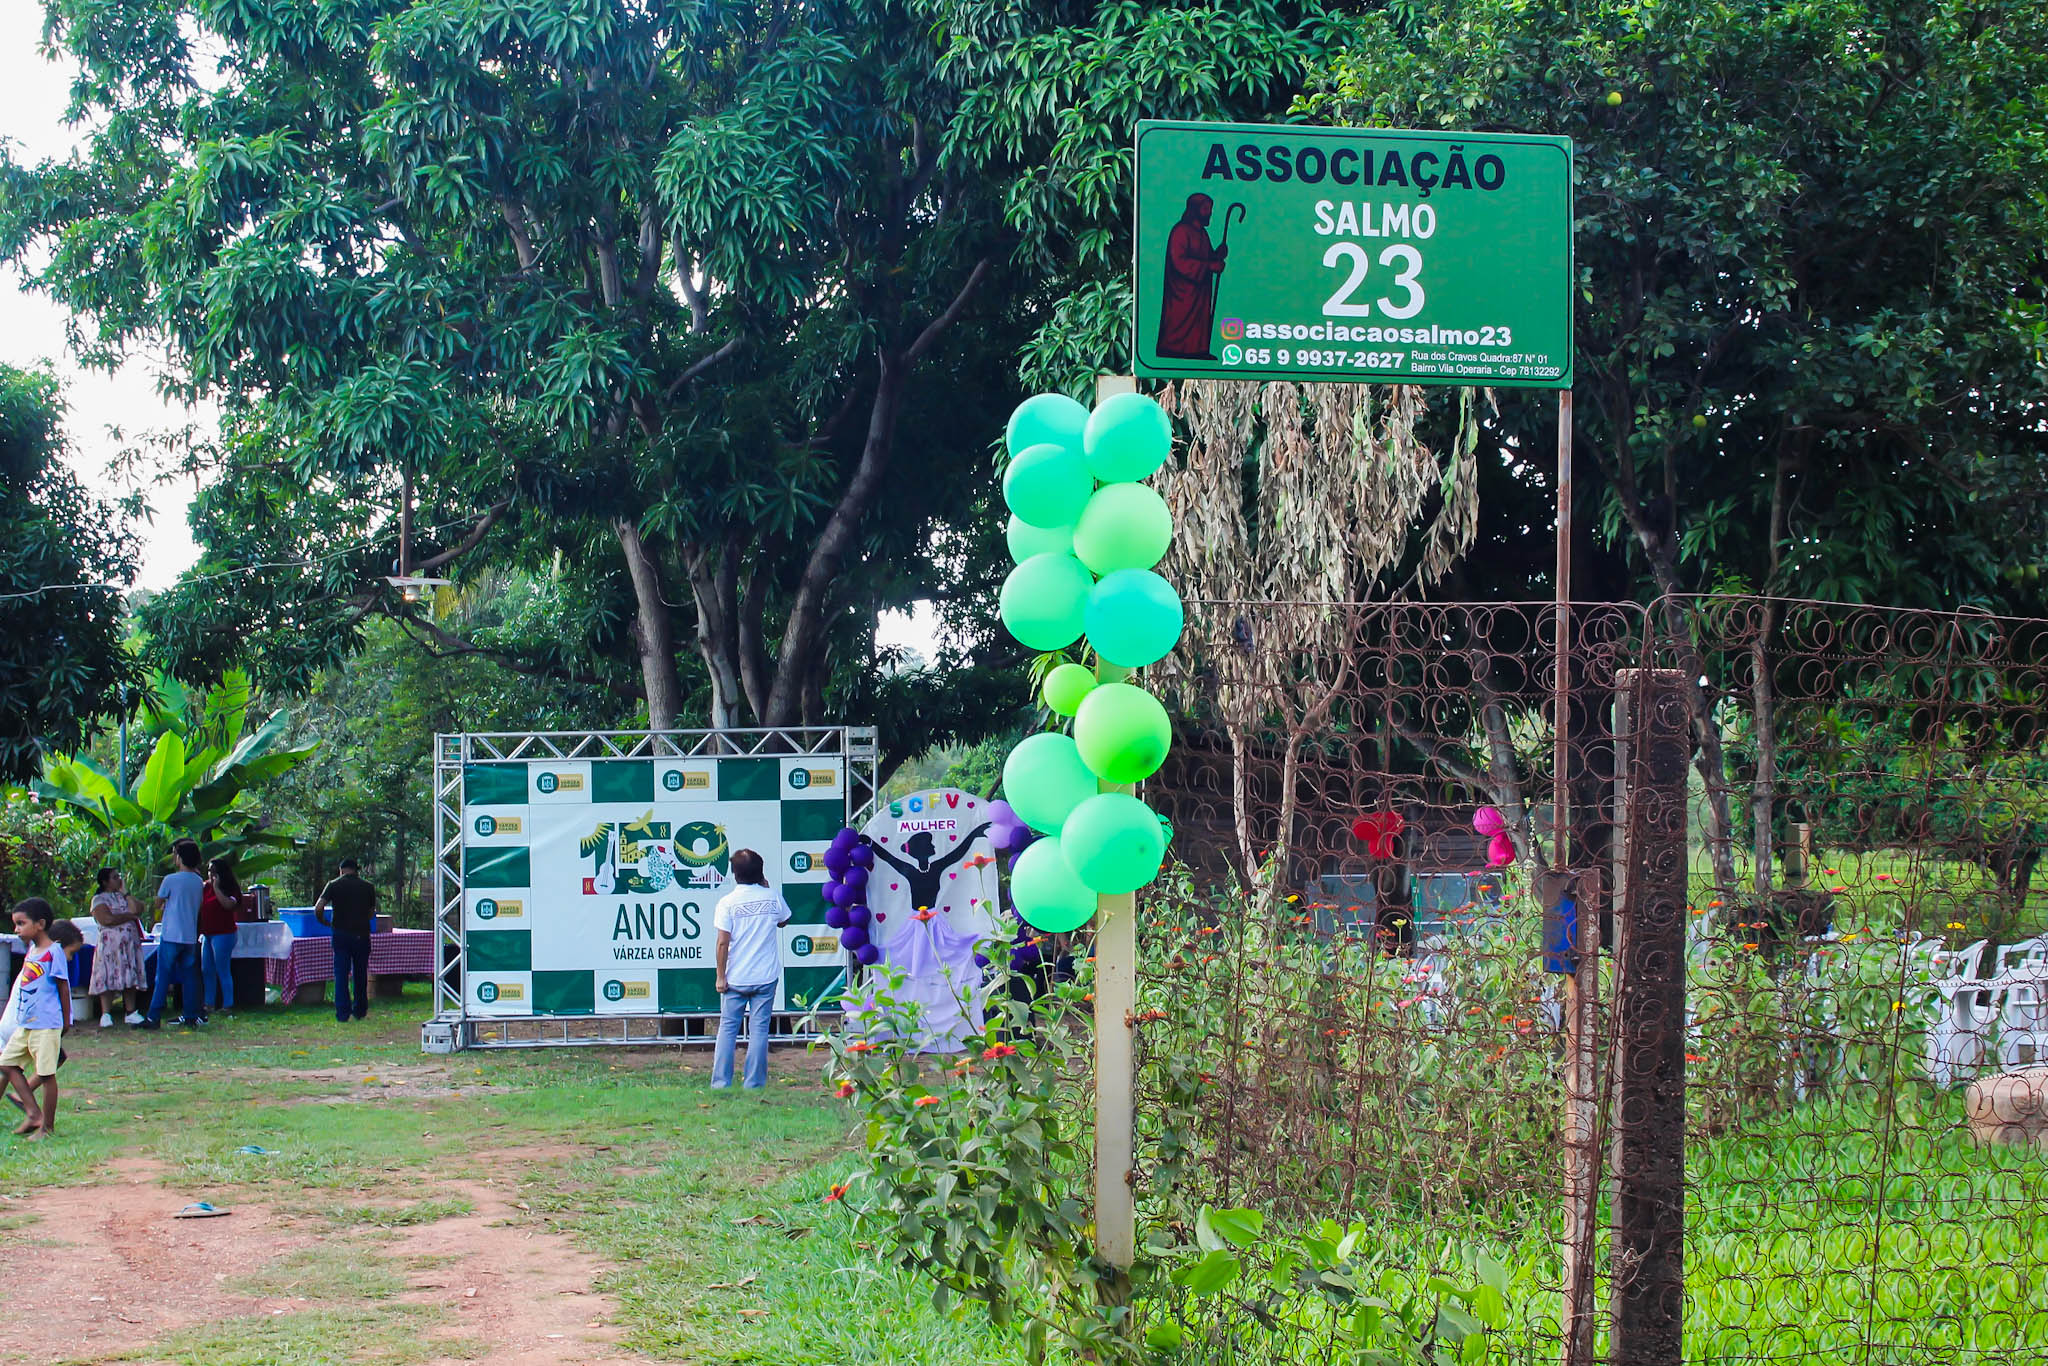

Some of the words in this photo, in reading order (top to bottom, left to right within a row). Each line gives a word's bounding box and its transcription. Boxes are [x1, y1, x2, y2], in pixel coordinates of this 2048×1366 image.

[1201, 144, 1506, 198] ASSOCIAÇÃO
[1313, 200, 1436, 239] SALMO
[1322, 242, 1425, 319] 23
[1245, 320, 1512, 347] associacaosalmo23
[1245, 348, 1271, 364] 65
[1277, 349, 1290, 365] 9
[1296, 350, 1405, 369] 9937-2627
[1411, 351, 1429, 361] Rua
[1431, 351, 1446, 361] dos
[1448, 352, 1478, 362] Cravos
[1537, 354, 1548, 364] 01
[1411, 363, 1436, 373] Bairro
[1438, 363, 1454, 373] Vila
[1455, 364, 1492, 375] Operaria
[1499, 366, 1517, 377] Cep
[1519, 366, 1560, 377] 78132292
[900, 820, 956, 832] MULHER
[612, 902, 701, 940] ANOS
[613, 945, 654, 960] VÁRZEA
[658, 946, 702, 960] GRANDE
